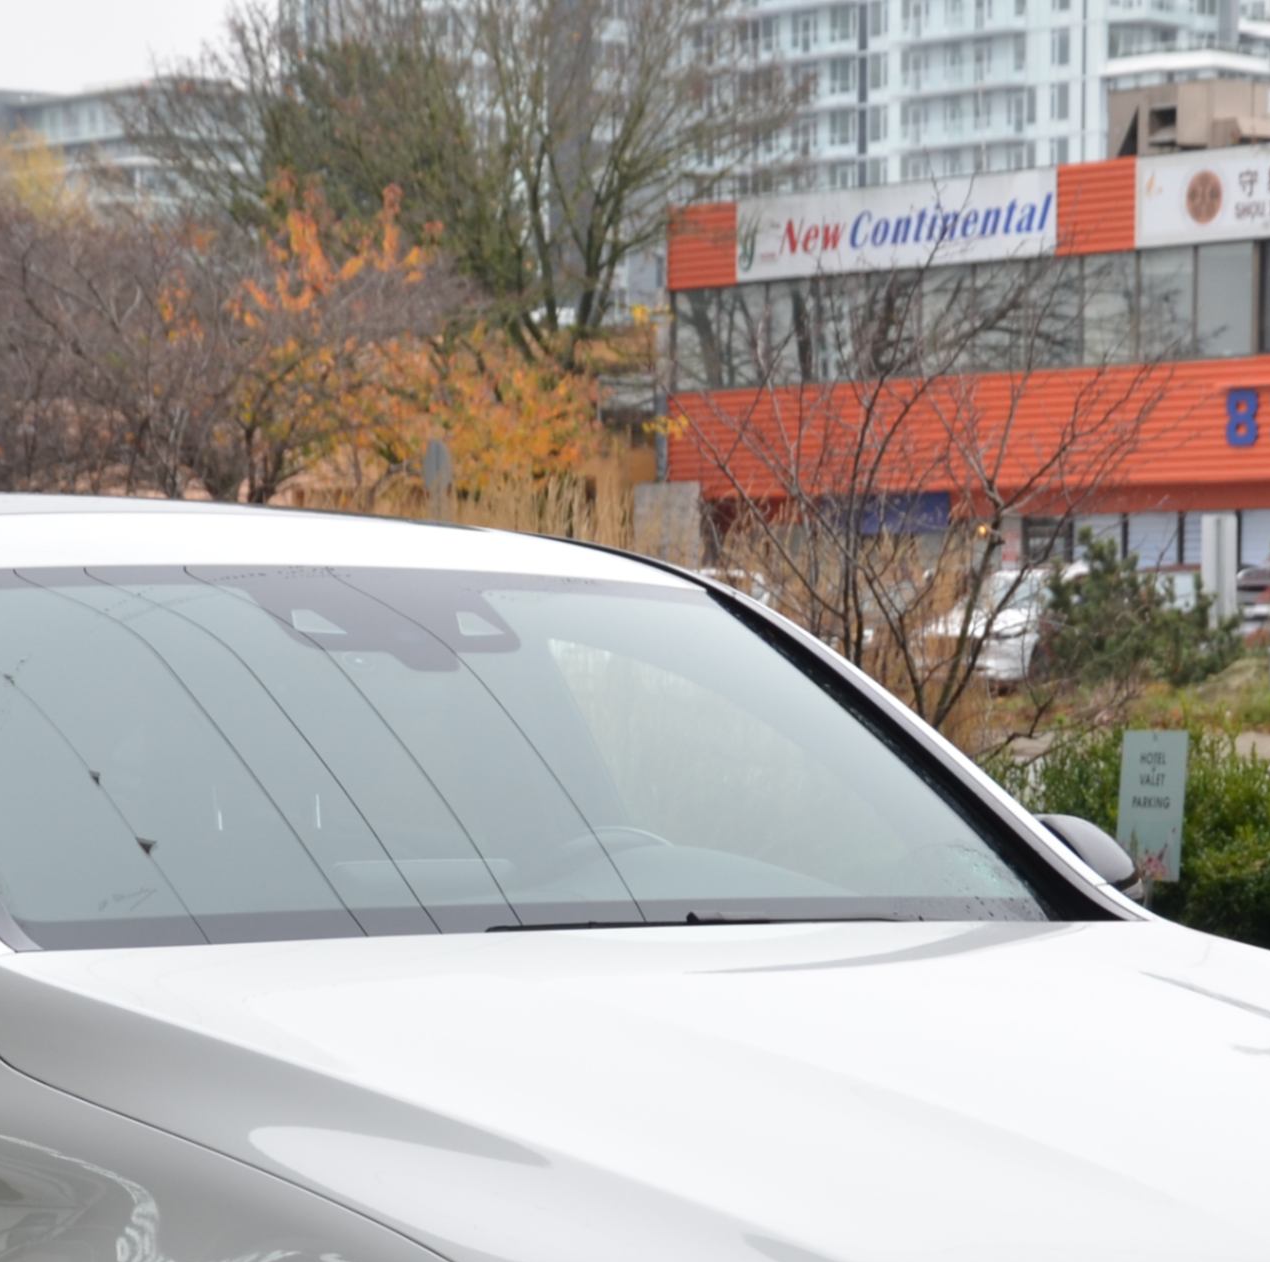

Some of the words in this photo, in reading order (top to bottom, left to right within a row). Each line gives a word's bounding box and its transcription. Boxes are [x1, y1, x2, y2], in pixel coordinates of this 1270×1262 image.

[779, 217, 843, 256] New
[849, 192, 1052, 249] Continental
[1140, 752, 1166, 765] HOTEL
[1139, 774, 1166, 786] VALET
[1132, 796, 1171, 809] PARKING
